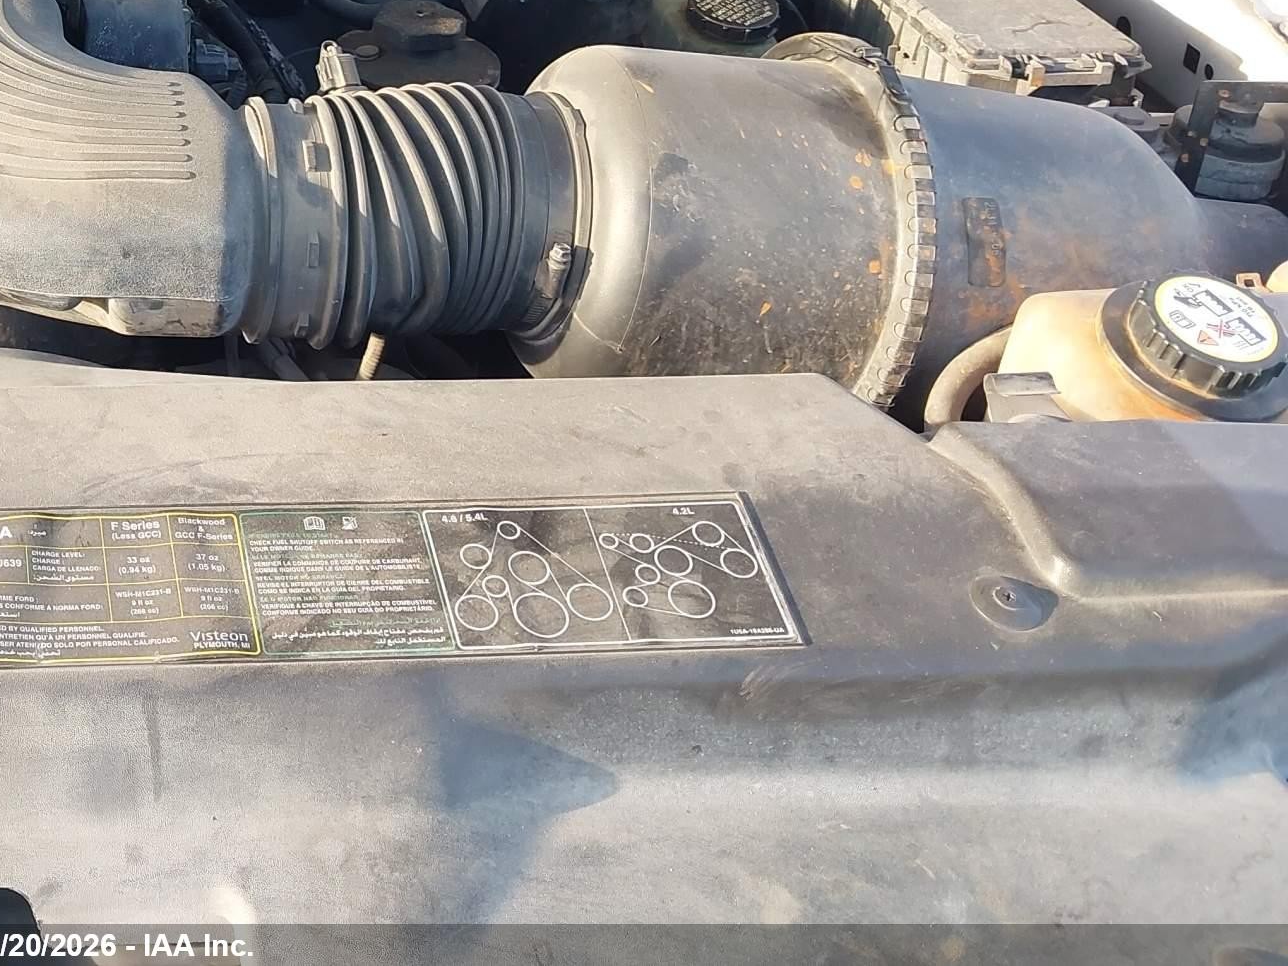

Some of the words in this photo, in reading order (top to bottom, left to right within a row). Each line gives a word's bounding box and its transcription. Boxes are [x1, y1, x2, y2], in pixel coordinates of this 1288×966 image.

[672, 507, 695, 516] 4.2L
[178, 517, 225, 525] Blackwood
[466, 513, 488, 523] 5.4L
[111, 521, 119, 531] F
[122, 520, 161, 531] Series
[111, 533, 136, 541] (Less
[138, 530, 162, 539] GCC)
[175, 531, 195, 539] GCC
[197, 532, 233, 540] F-Series
[190, 630, 249, 641] Visteon
